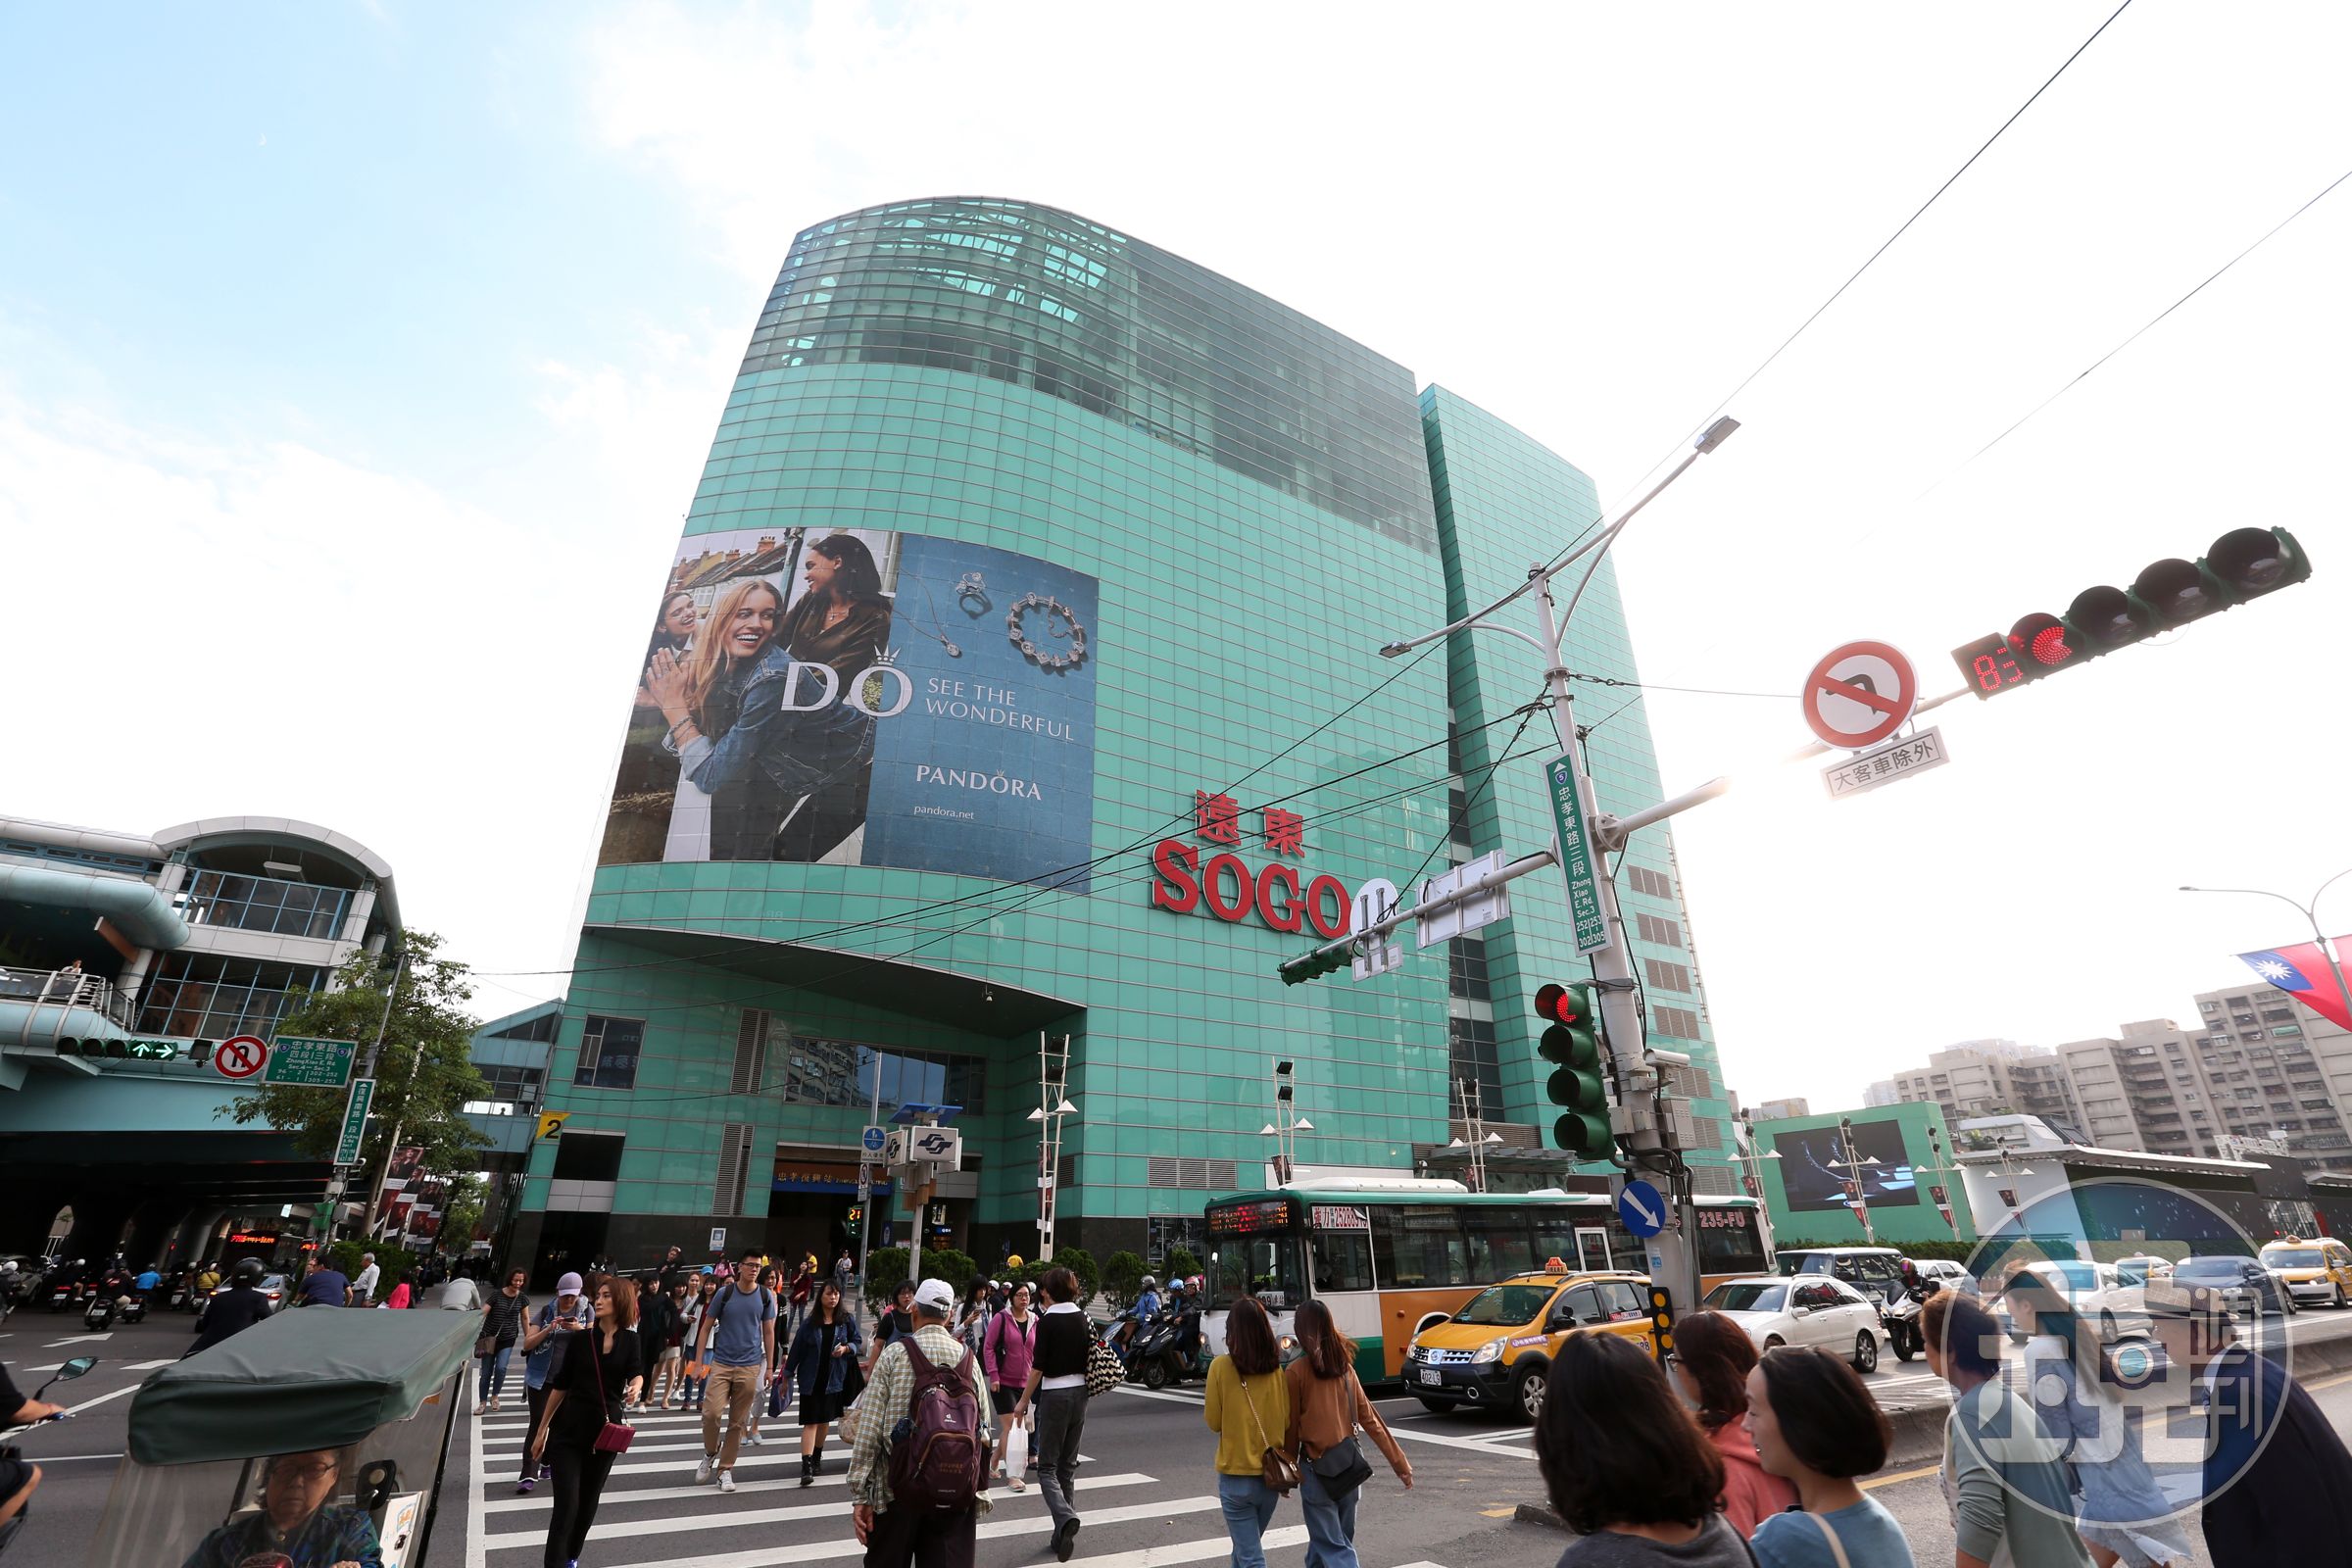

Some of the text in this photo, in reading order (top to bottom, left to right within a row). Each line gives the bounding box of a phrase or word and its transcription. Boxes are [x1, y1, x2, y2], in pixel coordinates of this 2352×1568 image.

[927, 677, 1016, 707] SEE THE
[925, 698, 1074, 741] WONDERFUL
[1834, 741, 1934, 791] 大客車除外
[916, 764, 1042, 801] PANDORA
[913, 805, 975, 820] pandora.net
[1195, 789, 1305, 858] 遠東
[1558, 786, 1586, 877] 忠孝東路三段
[1152, 839, 1352, 940] SOGO
[1571, 878, 1592, 890] Zhong
[1573, 889, 1589, 900] Xiao
[1576, 914, 1602, 932] 252 253
[1579, 935, 1592, 948] 302
[291, 1041, 338, 1053] 忠孝東路
[545, 1119, 562, 1139] 2
[1698, 1211, 1745, 1228] 235-FU
